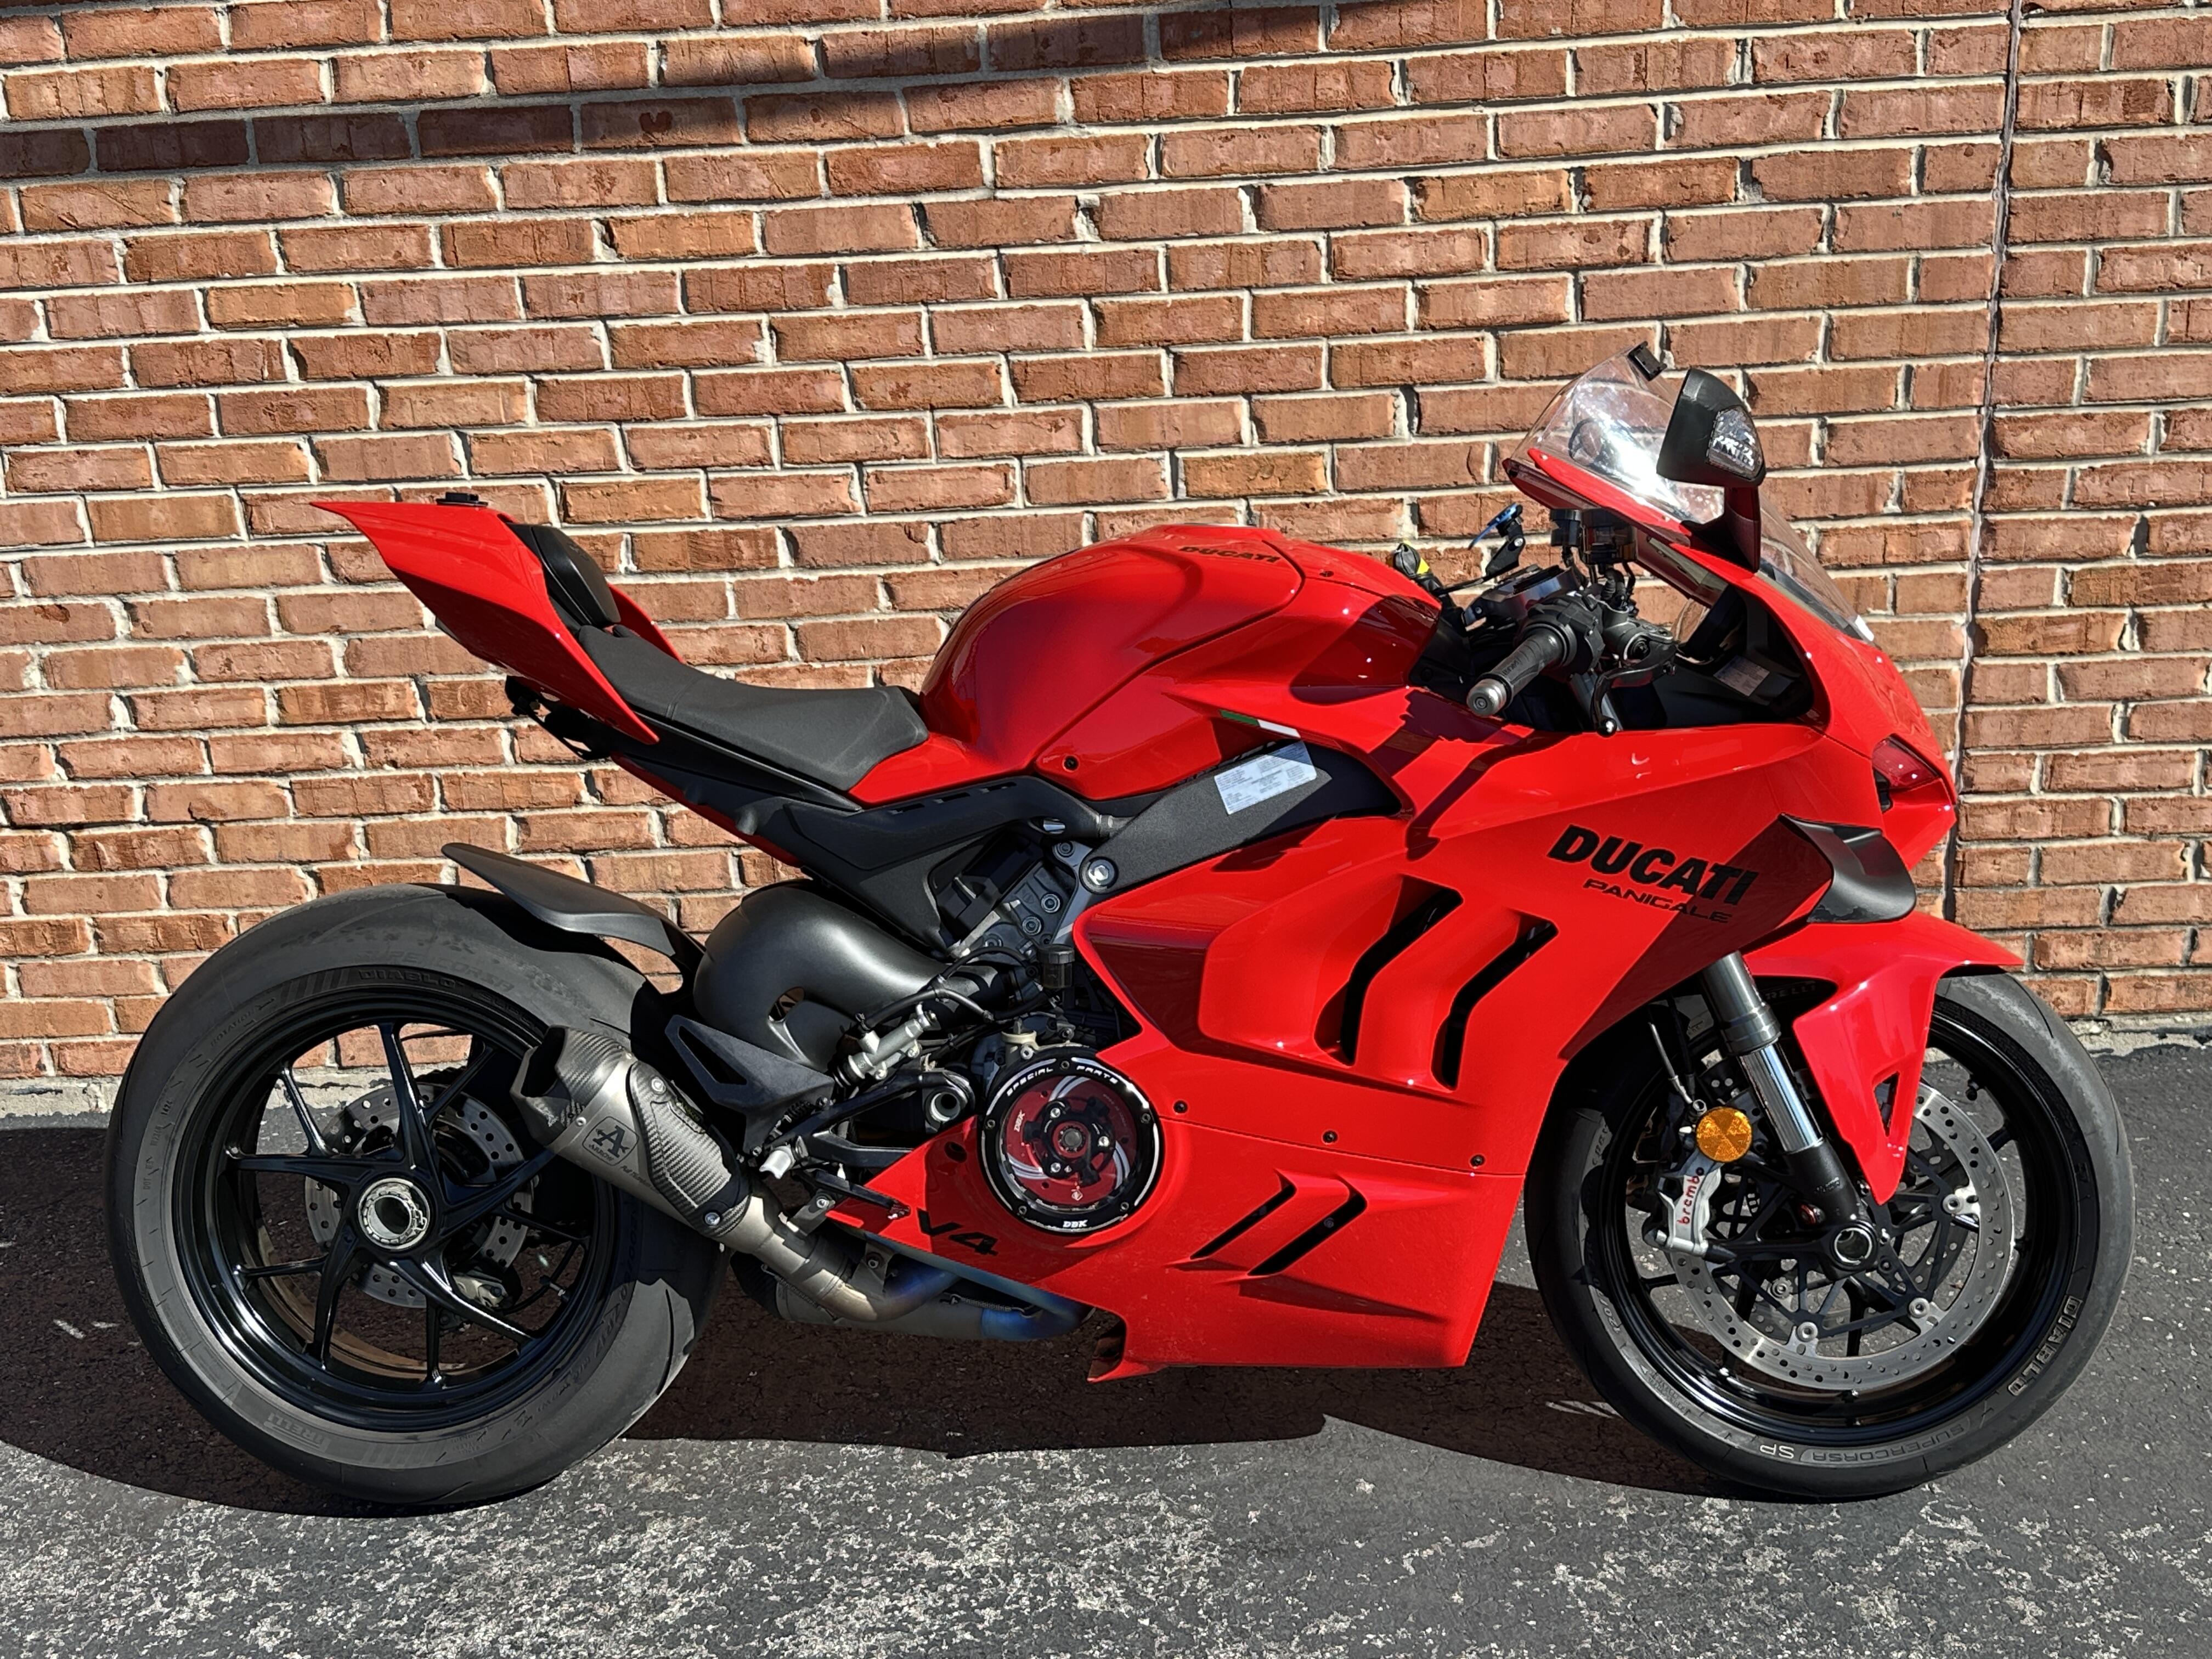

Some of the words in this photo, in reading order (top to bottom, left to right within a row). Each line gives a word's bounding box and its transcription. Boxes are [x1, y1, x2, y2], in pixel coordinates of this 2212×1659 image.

[1178, 545, 1280, 563] DUCATI
[1547, 824, 1759, 906] DUCATI
[1583, 878, 1732, 923] PANIGALE
[358, 969, 456, 988] DIABLO
[1763, 980, 1818, 1003] RELLI
[208, 1006, 255, 1048] ROTATION
[1006, 1066, 1053, 1096] SPECIAL
[1076, 1065, 1118, 1084] PARTS
[1014, 1110, 1025, 1132] DBK
[588, 1143, 614, 1163] ARROW
[1677, 1167, 1703, 1226] brembo
[917, 1210, 998, 1256] V4
[1063, 1220, 1088, 1228] DBK
[2008, 1296, 2083, 1396] DIABLO
[262, 1410, 331, 1453] PIRELLI
[1812, 1426, 1965, 1464] SUPERCORSA
[1759, 1444, 1795, 1459] SP
